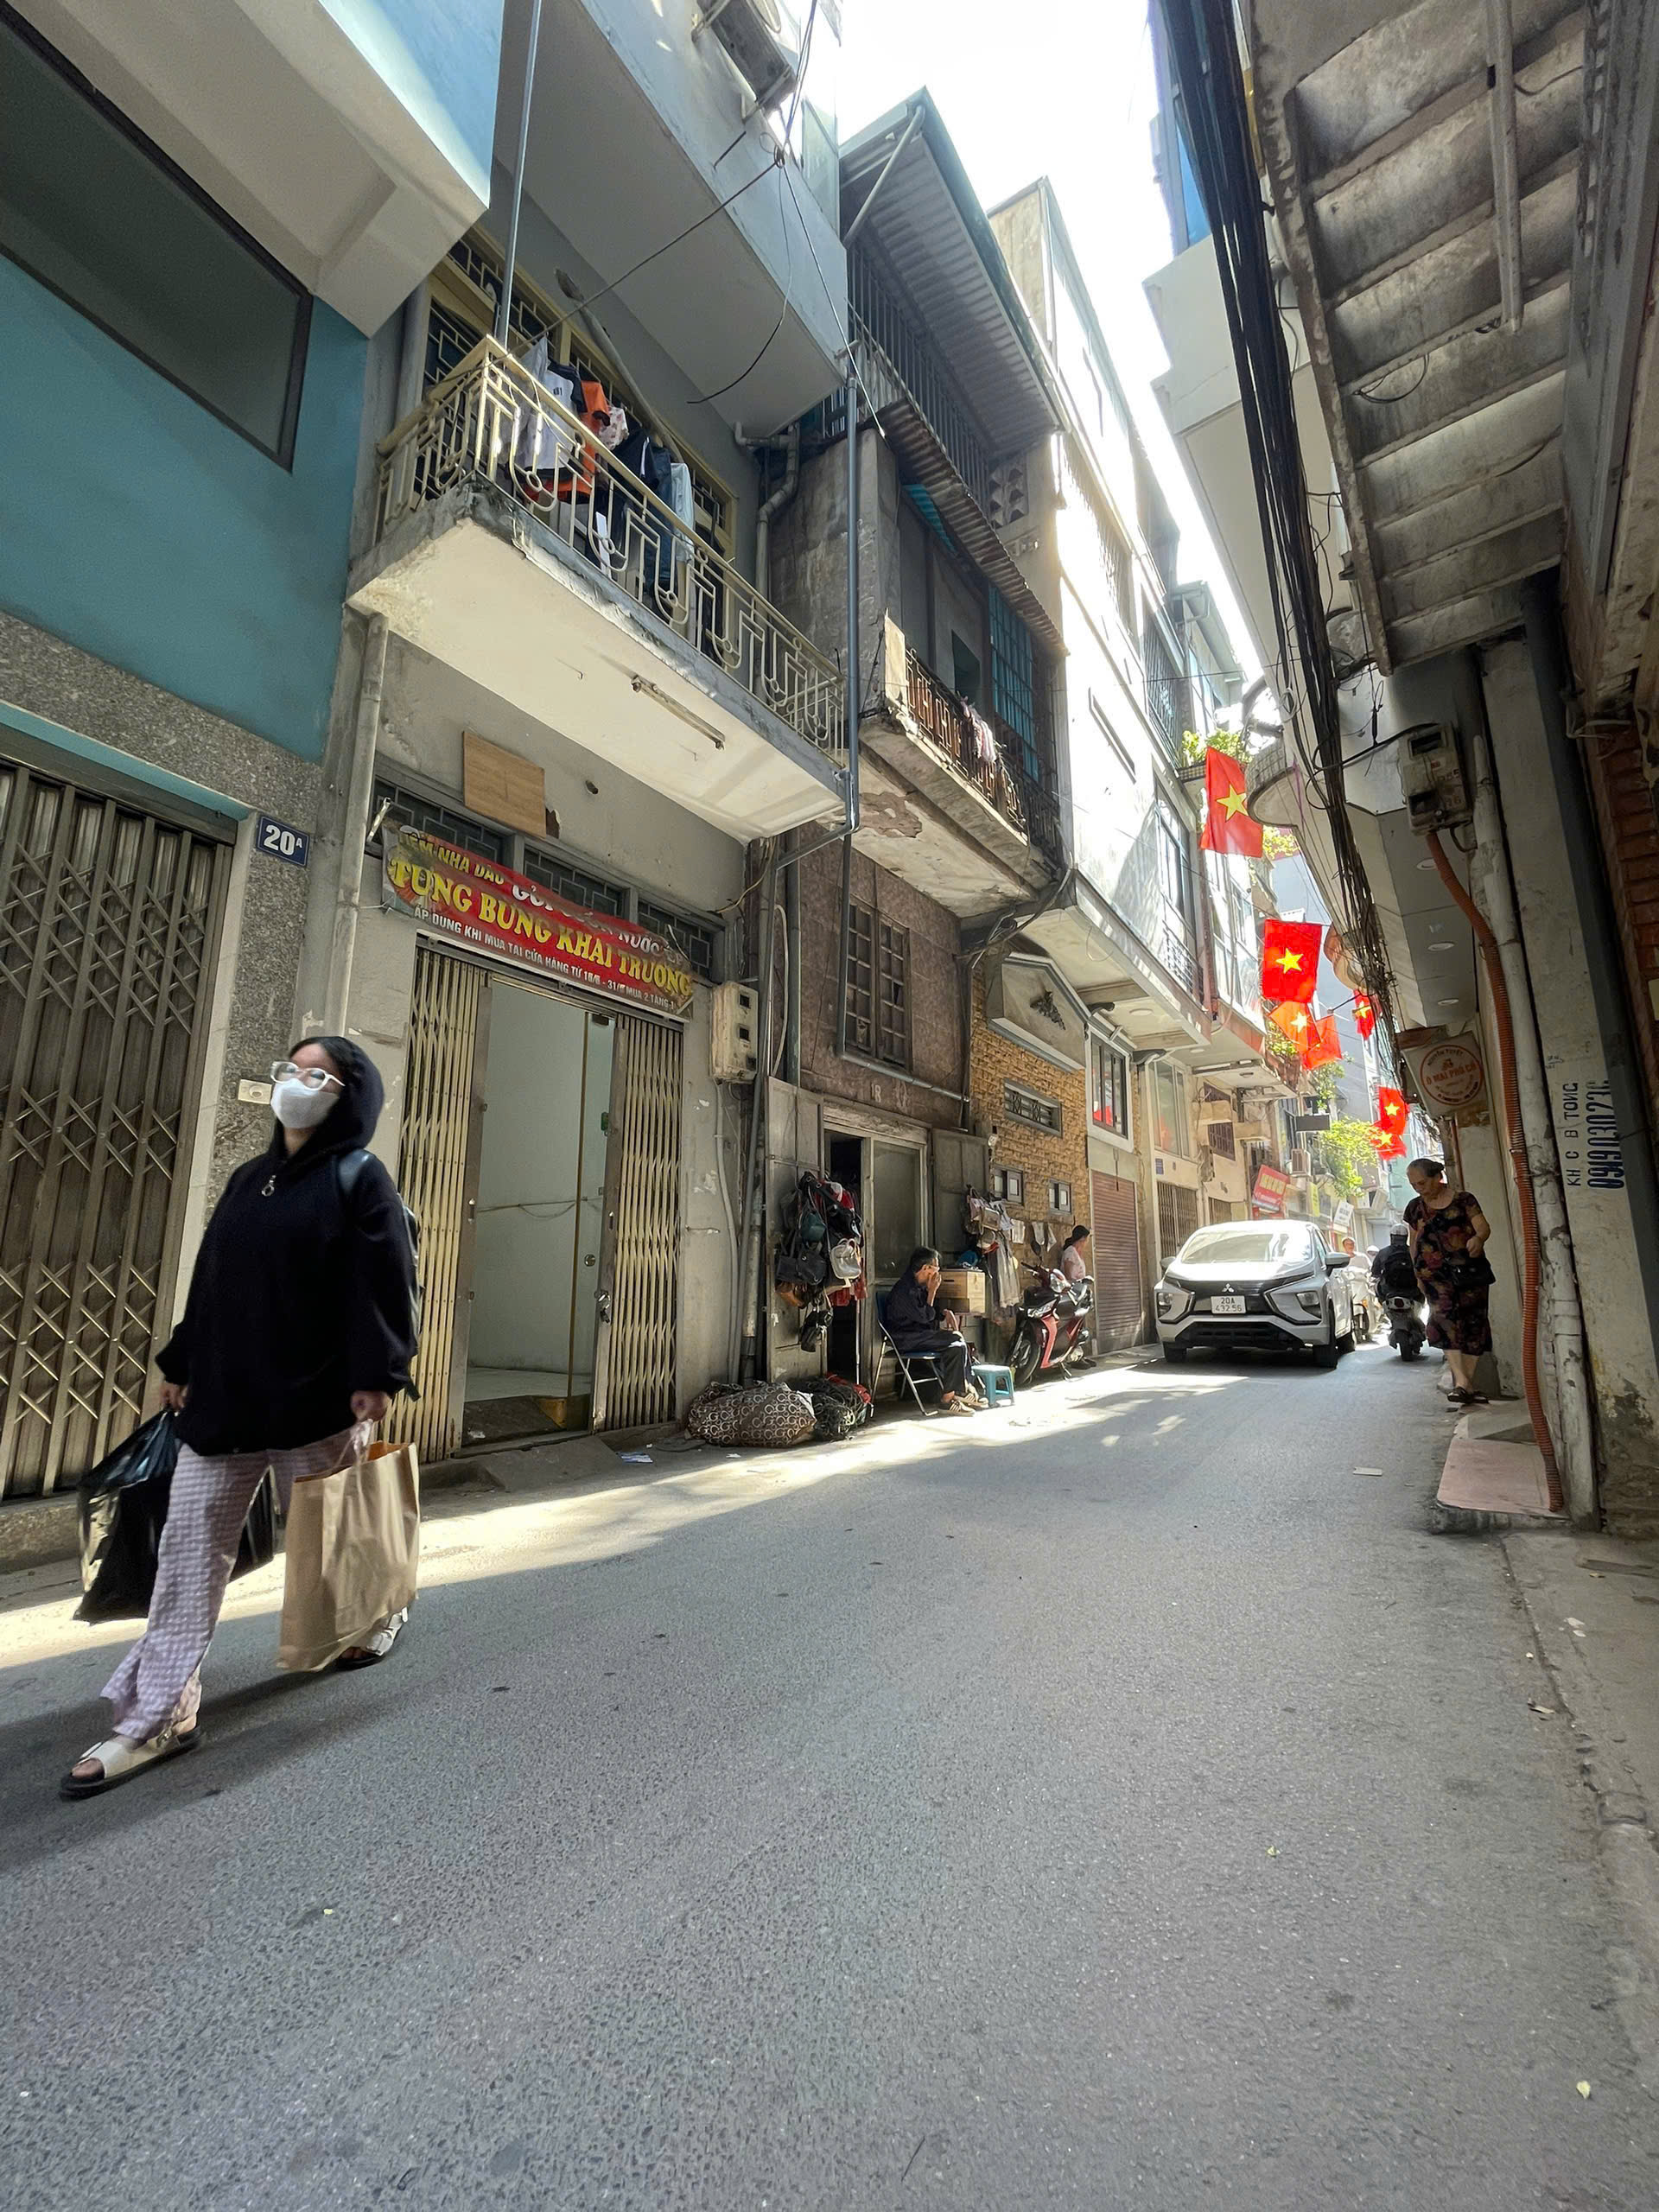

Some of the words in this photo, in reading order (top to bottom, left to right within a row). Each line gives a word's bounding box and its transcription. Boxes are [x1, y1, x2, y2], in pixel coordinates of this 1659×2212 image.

[264, 824, 302, 855] 20A
[556, 926, 613, 968] KHAI
[464, 925, 482, 941] KHI
[485, 934, 505, 950] MUA
[644, 993, 650, 1001] 2
[1564, 1129, 1579, 1138] B
[1565, 1150, 1580, 1160] C
[1566, 1168, 1581, 1186] KH
